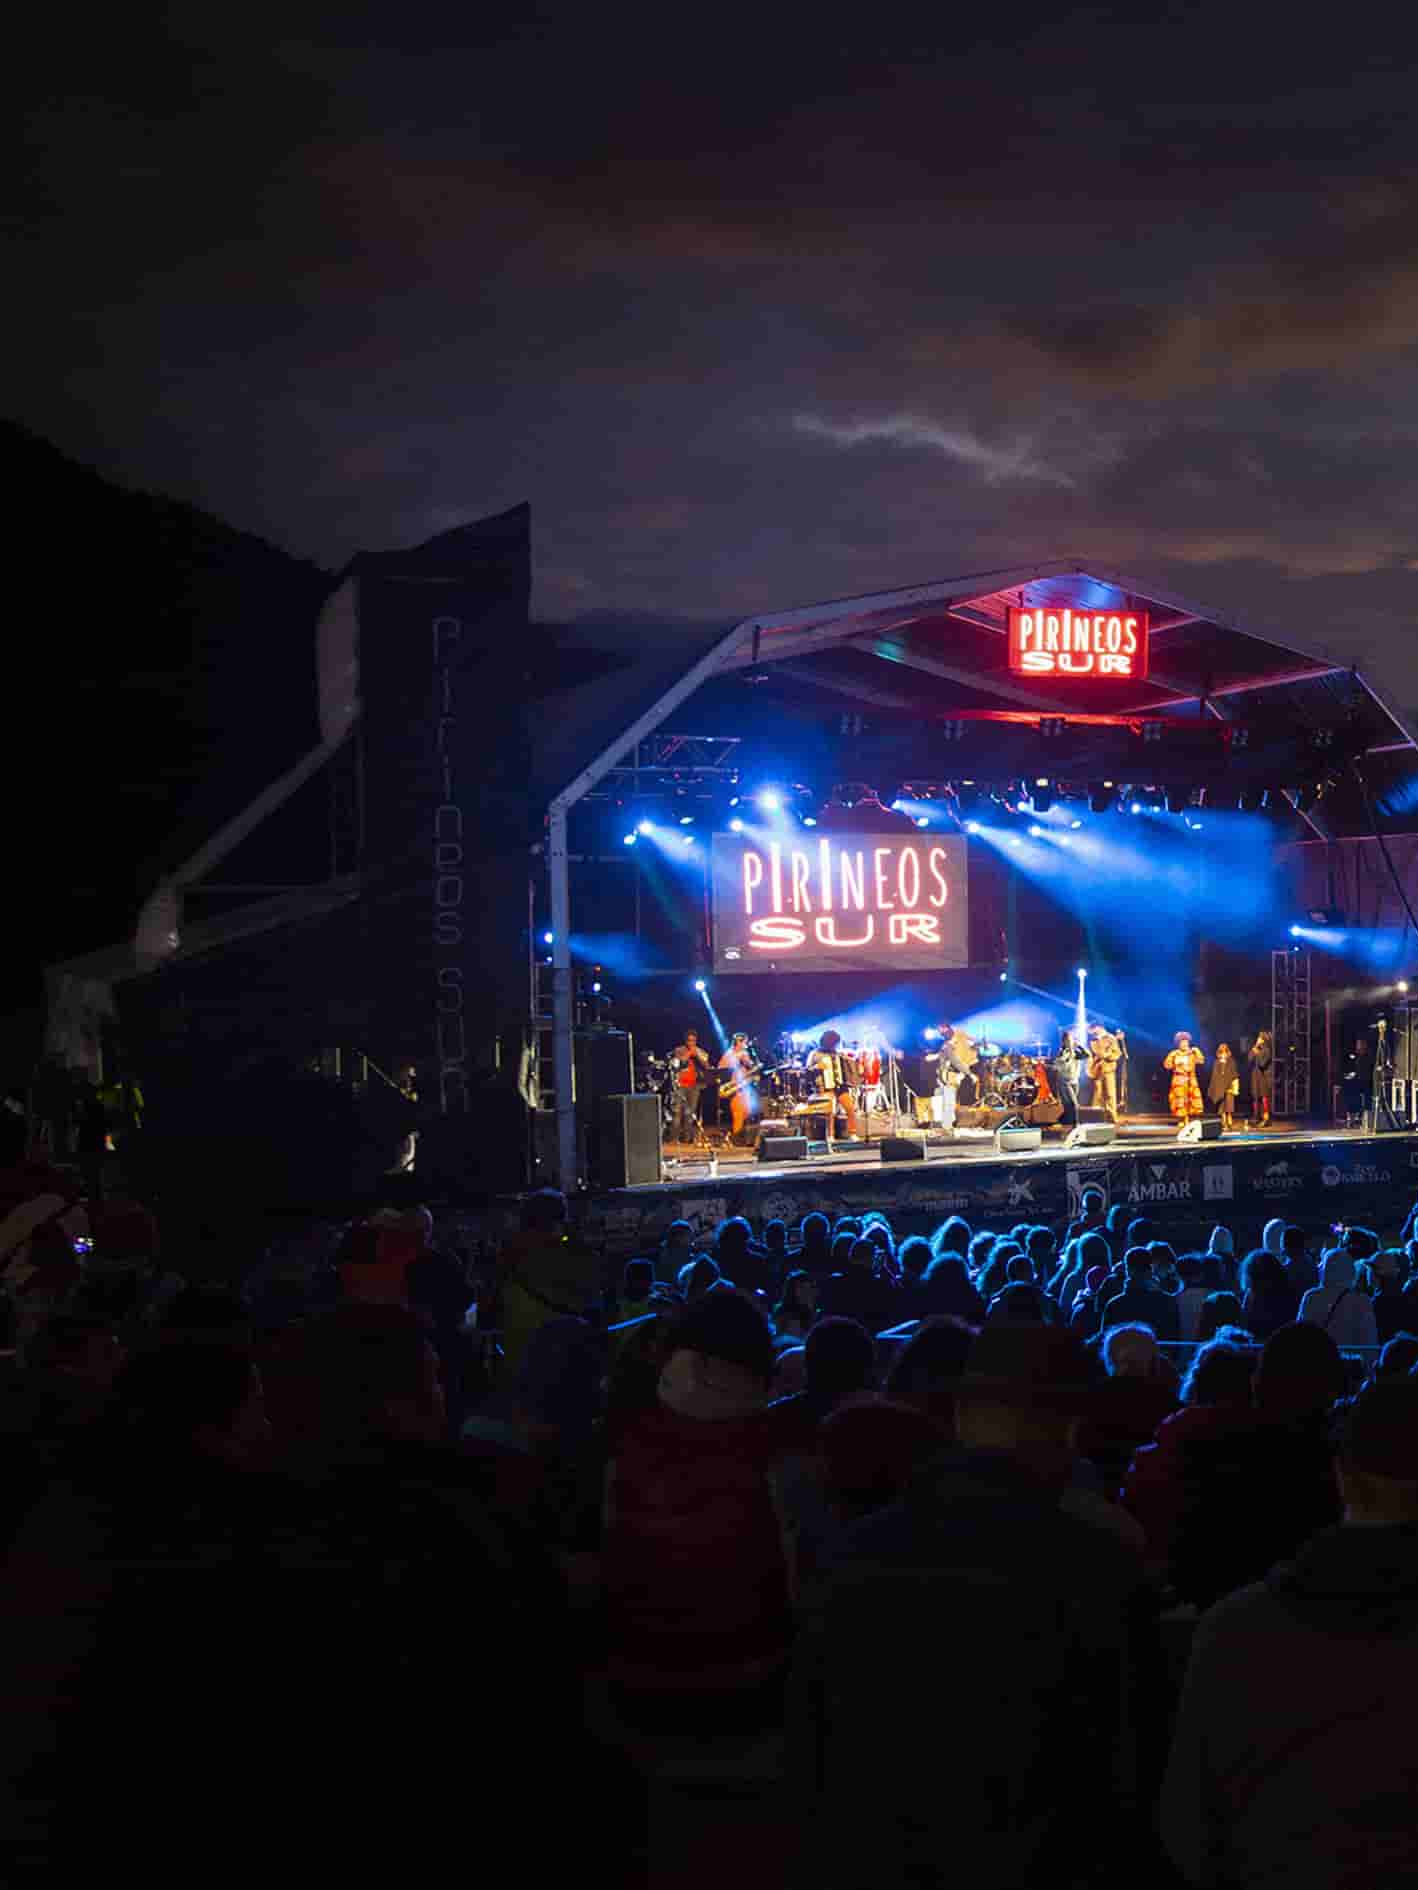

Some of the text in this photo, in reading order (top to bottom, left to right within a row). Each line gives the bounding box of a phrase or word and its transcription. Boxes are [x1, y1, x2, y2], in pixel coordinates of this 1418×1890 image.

[1019, 609, 1137, 654] PIRINEOS
[1020, 651, 1132, 674] SUR
[743, 838, 948, 914] PIRINEOS
[748, 913, 941, 949] SUR
[1127, 1180, 1193, 1202] AMBAR
